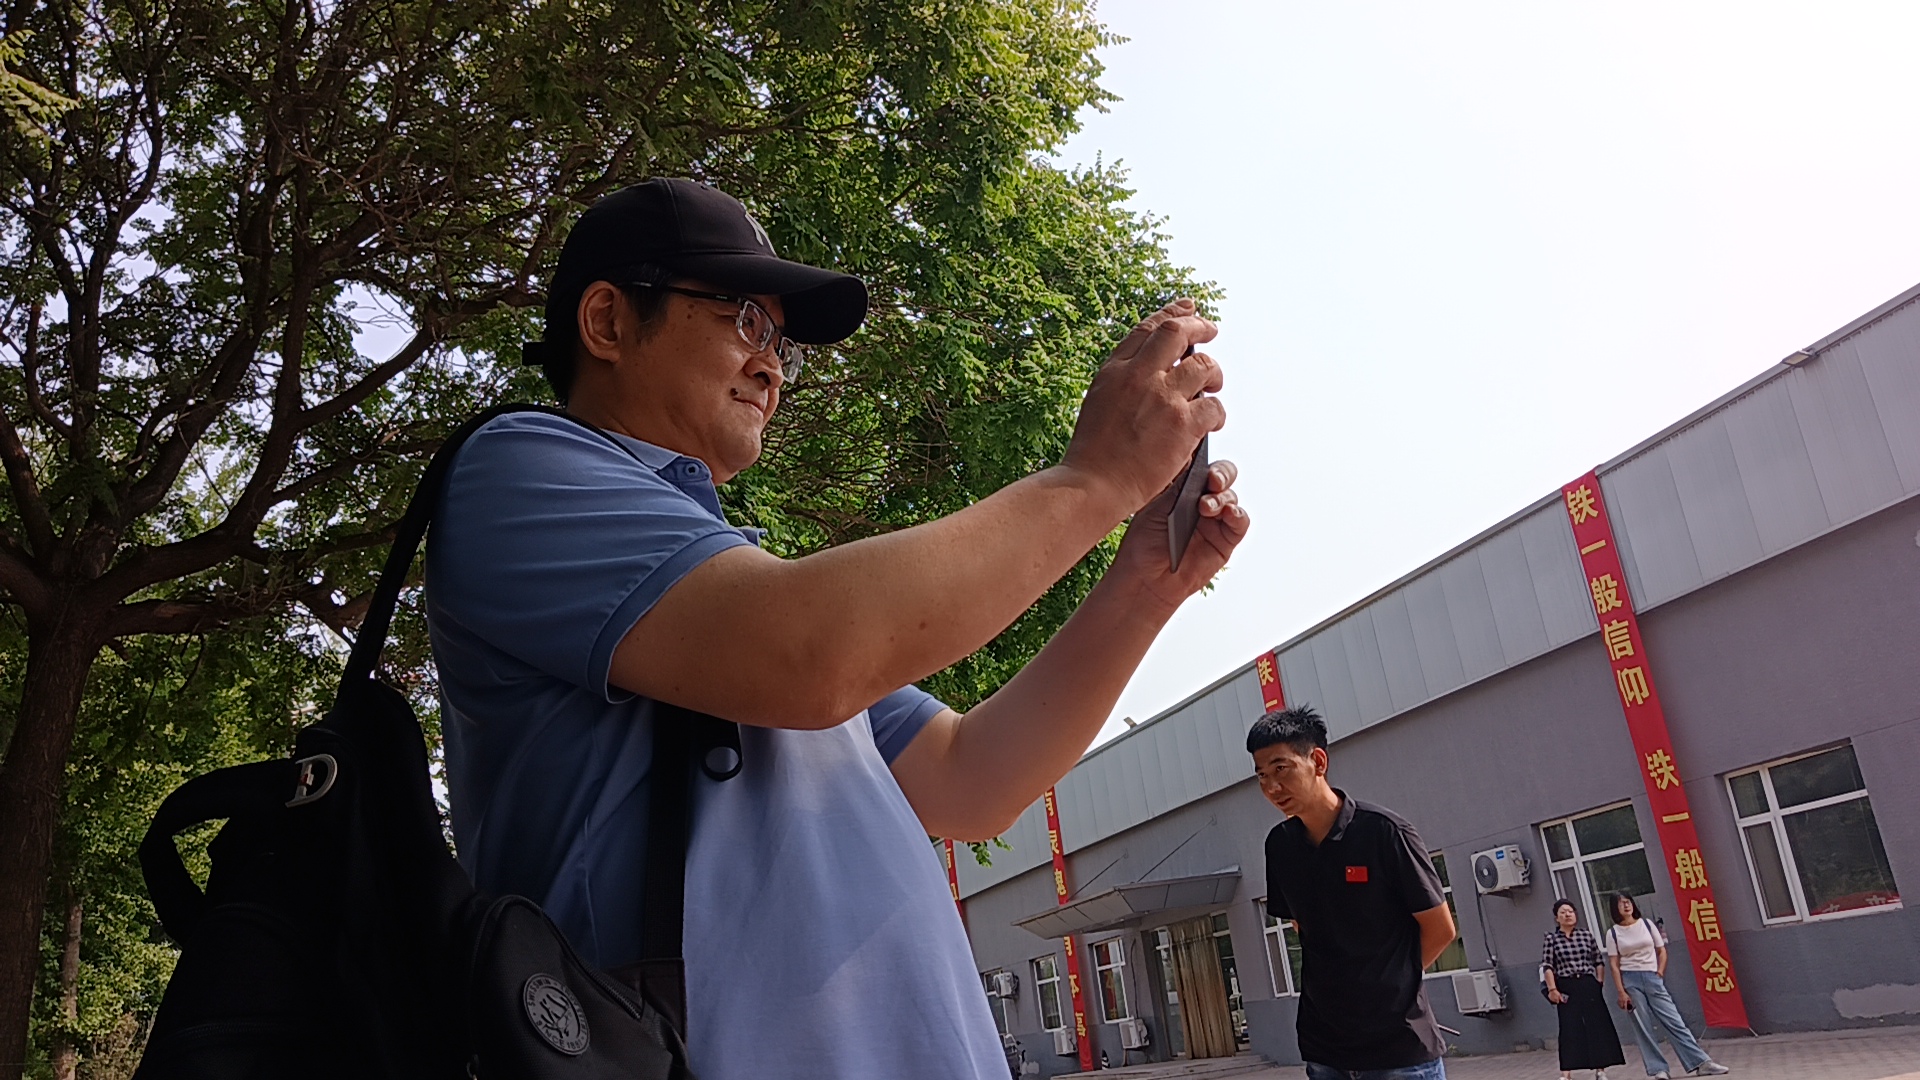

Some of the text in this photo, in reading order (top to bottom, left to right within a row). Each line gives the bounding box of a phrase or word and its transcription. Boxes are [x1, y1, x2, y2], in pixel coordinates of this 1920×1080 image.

[1566, 484, 1735, 994] 铁一般信仰 铁一般信念
[536, 1020, 566, 1048] SINCE
